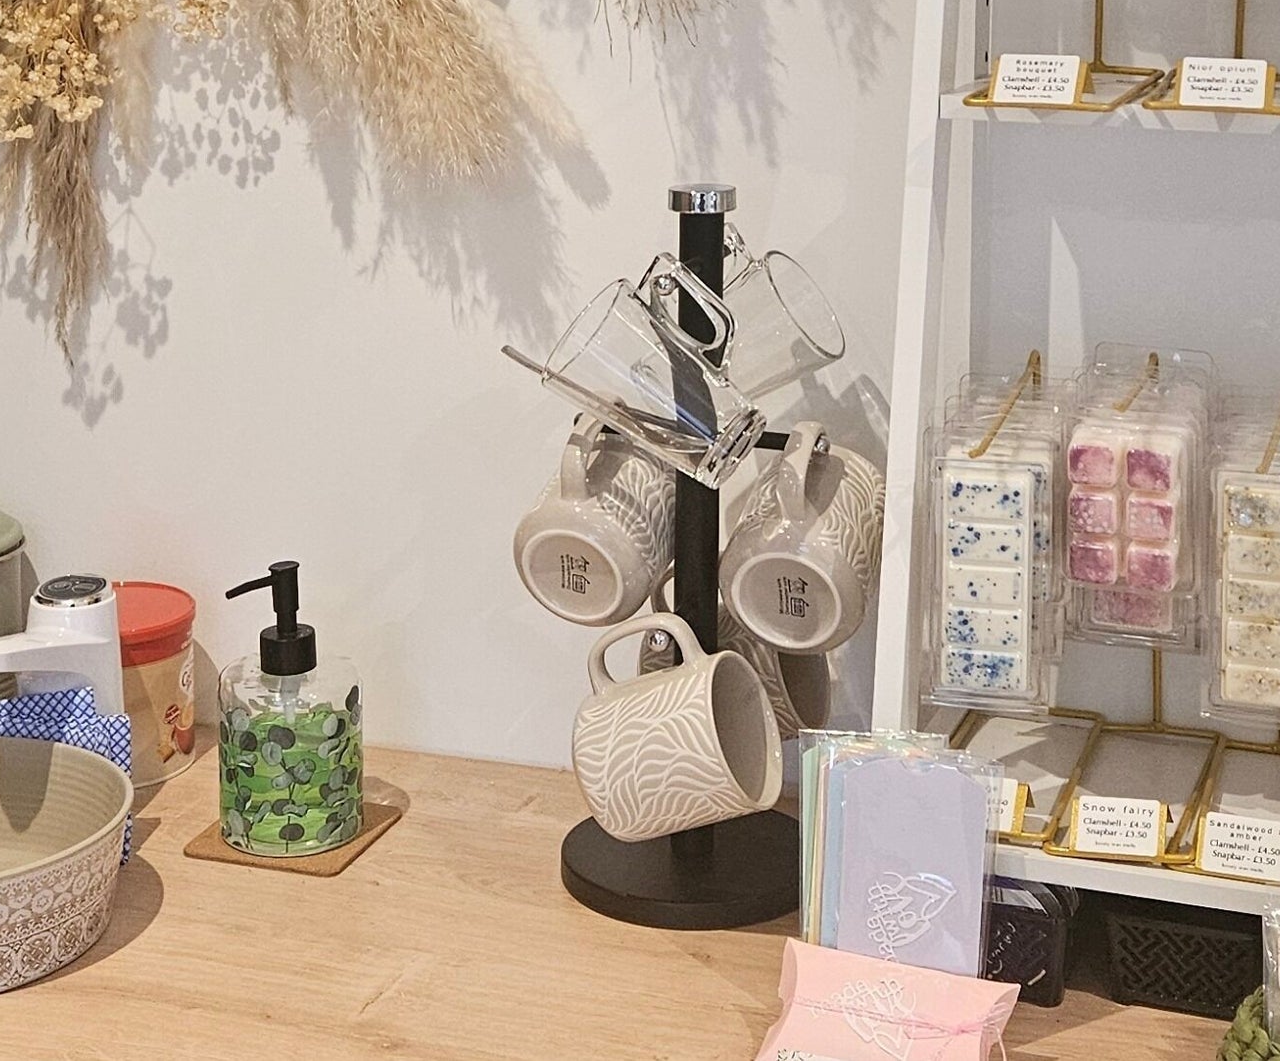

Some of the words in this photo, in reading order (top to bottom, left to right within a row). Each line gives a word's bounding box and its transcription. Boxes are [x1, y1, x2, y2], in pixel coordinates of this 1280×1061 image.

[1083, 803, 1115, 812] Snow
[1123, 806, 1155, 817] fairy
[1083, 818, 1121, 827] Clamshell
[1210, 820, 1273, 835] Sandalwood
[1086, 828, 1117, 837] Snapbar
[1230, 833, 1263, 842] amber
[1210, 839, 1250, 851] Clamshell
[1257, 847, 1280, 856] £4.50
[1212, 850, 1245, 861] Snapbar
[1253, 856, 1276, 866] £3.50
